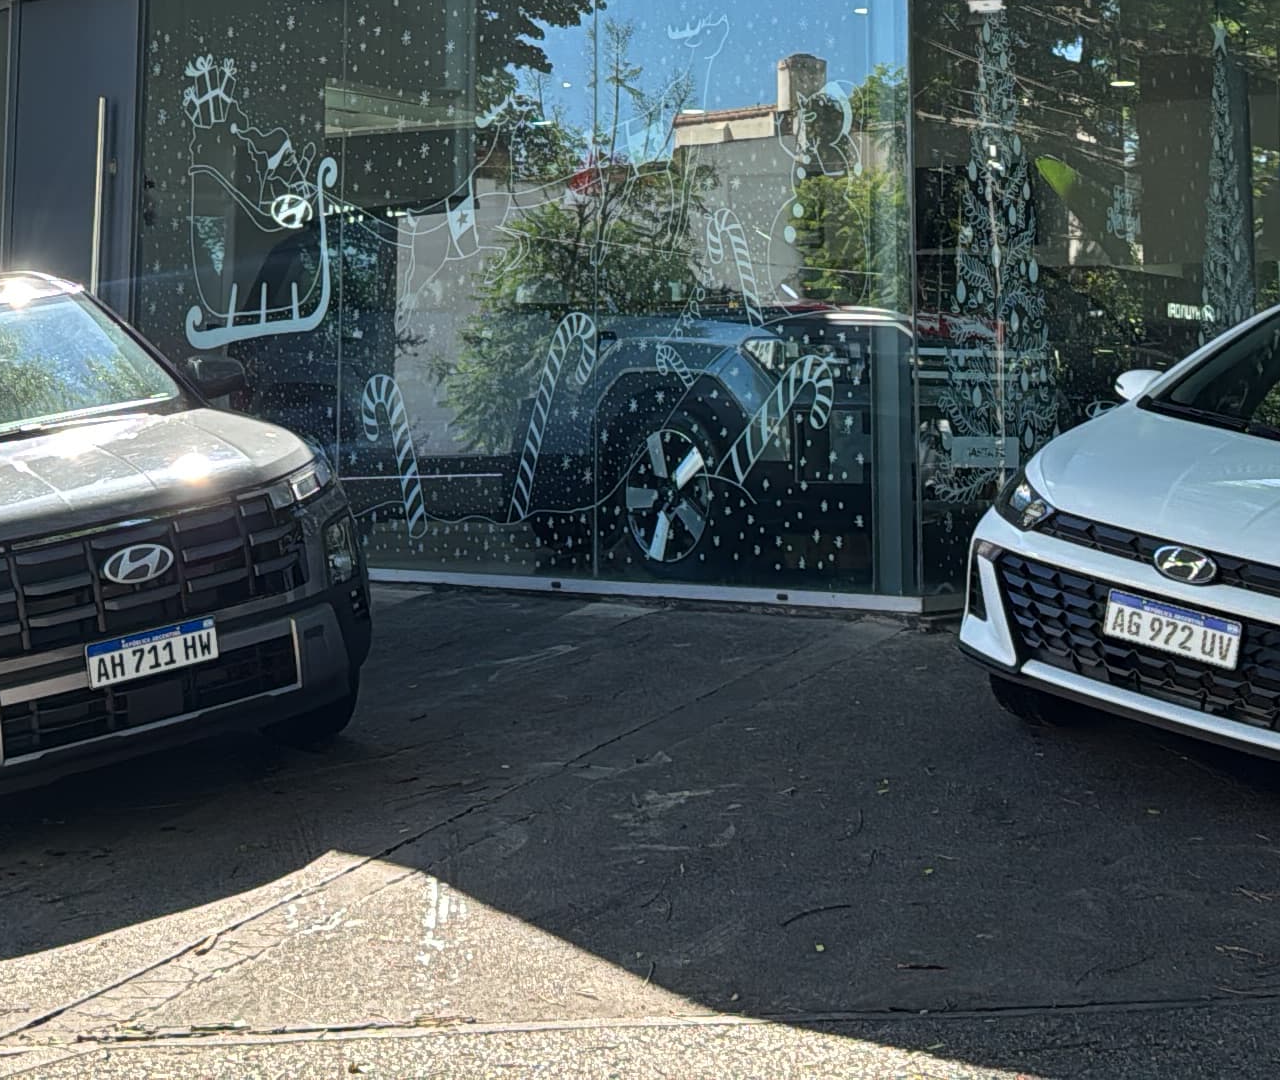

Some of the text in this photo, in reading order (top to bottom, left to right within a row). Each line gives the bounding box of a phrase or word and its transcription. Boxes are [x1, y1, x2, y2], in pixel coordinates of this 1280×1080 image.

[97, 631, 212, 683] AH 711 HW
[1111, 606, 1233, 662] AG 972 UV
